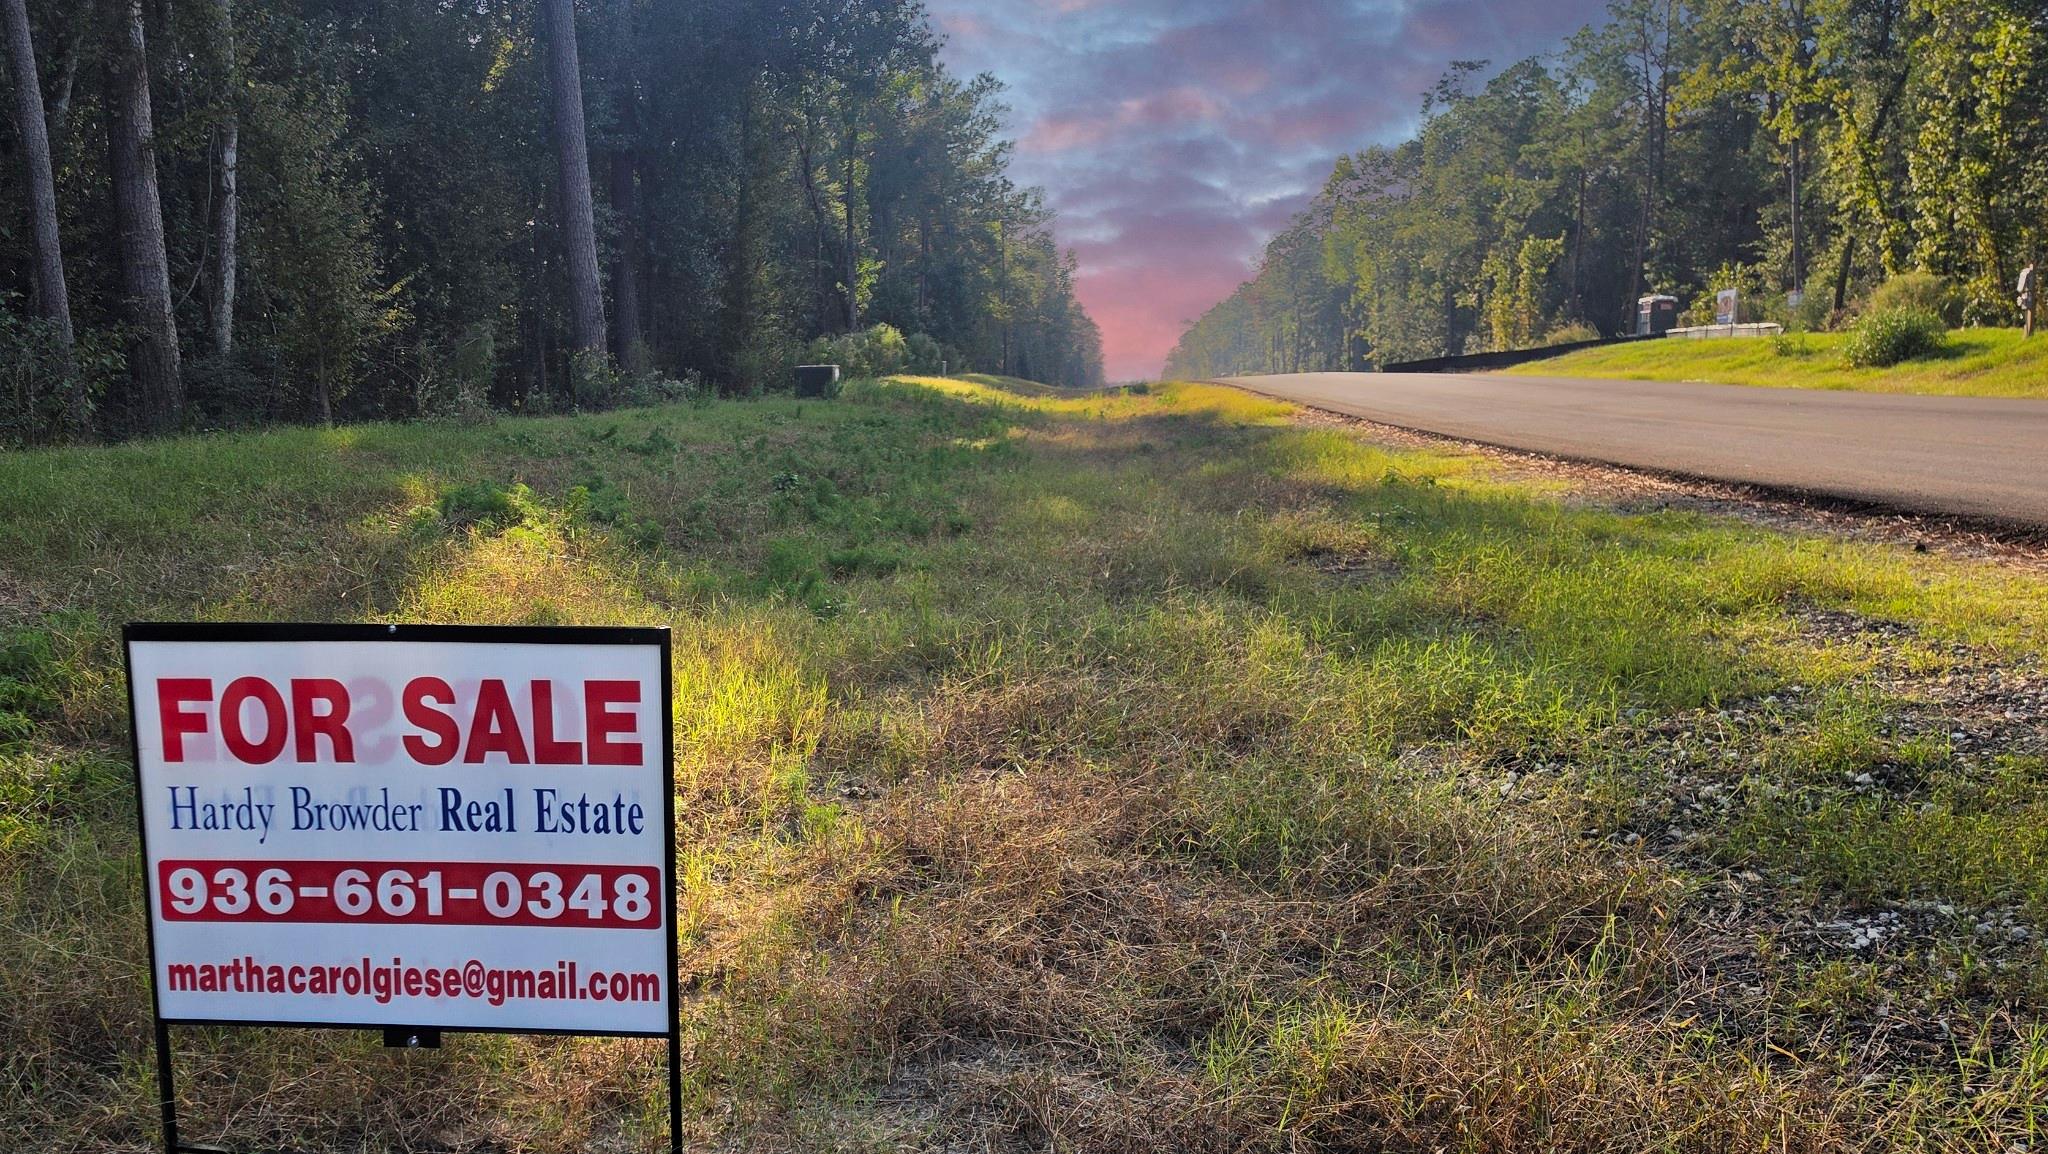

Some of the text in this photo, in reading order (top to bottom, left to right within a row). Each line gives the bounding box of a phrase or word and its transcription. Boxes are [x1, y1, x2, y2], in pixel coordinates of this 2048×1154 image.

[156, 676, 644, 766] FOR SALE
[167, 786, 644, 844] Hardy Browder Real Estate
[167, 867, 652, 920] 936-661-0348
[167, 957, 661, 1006] marthacarolgiese@gmail.com
